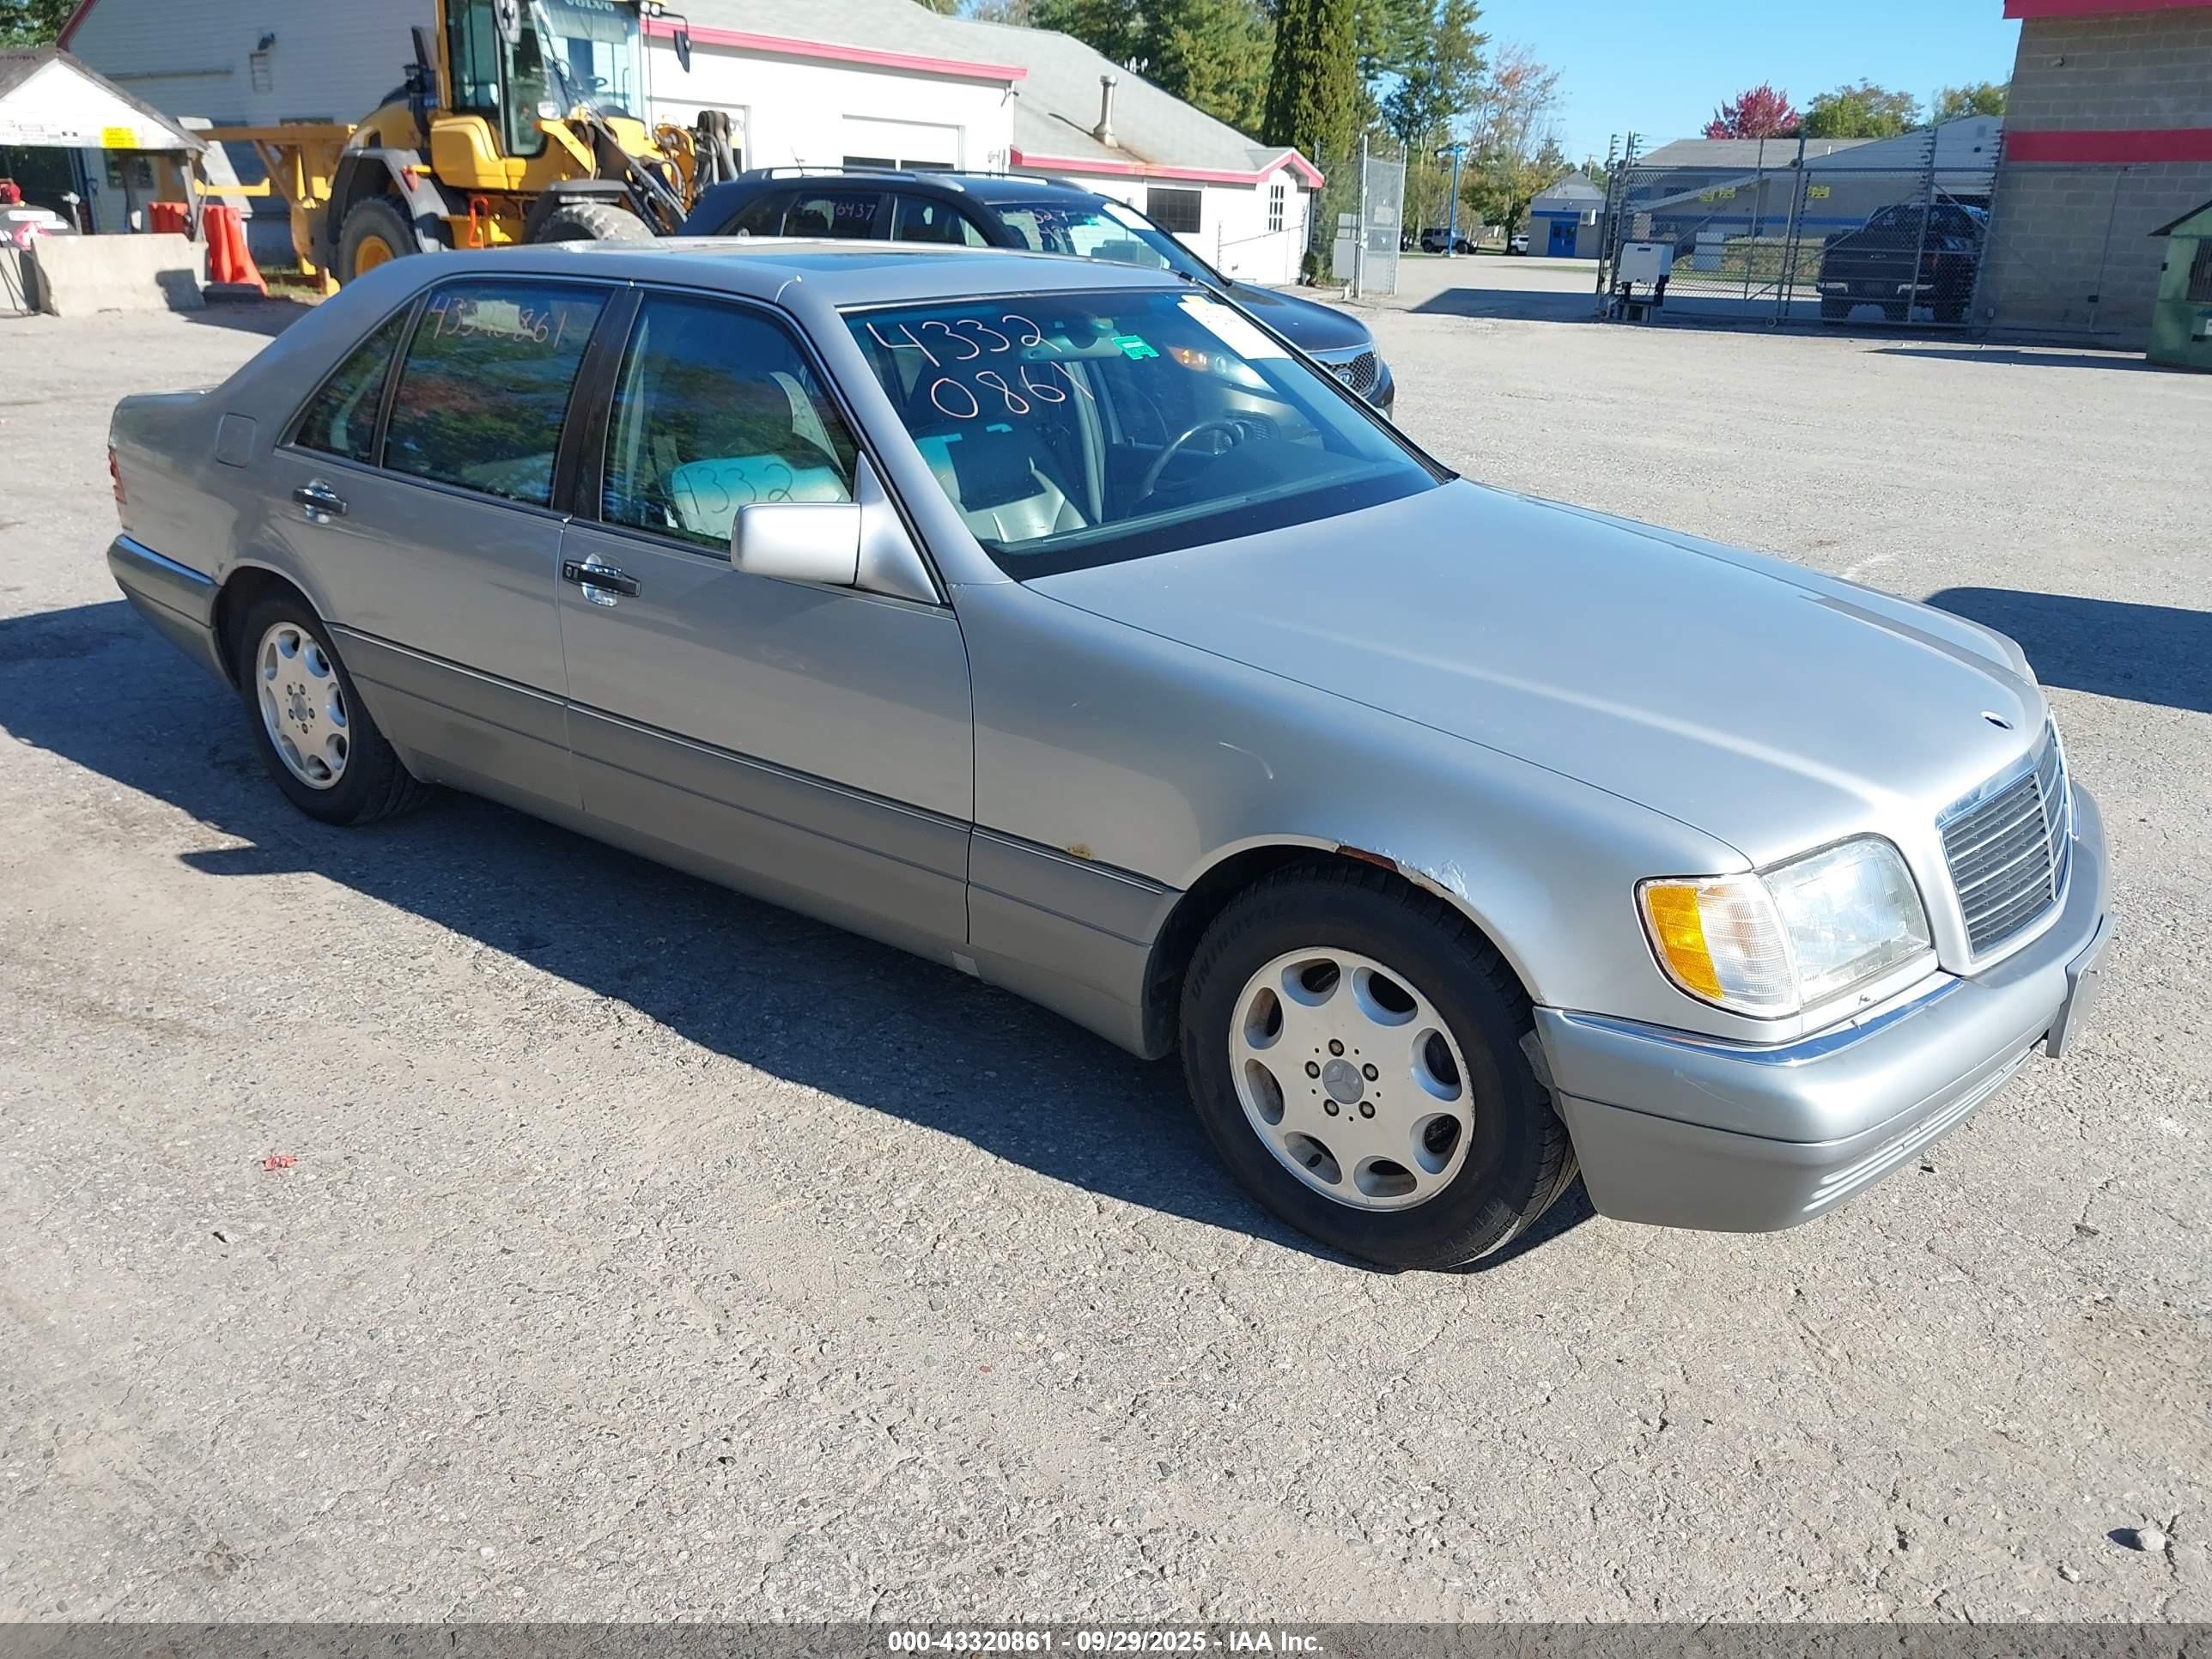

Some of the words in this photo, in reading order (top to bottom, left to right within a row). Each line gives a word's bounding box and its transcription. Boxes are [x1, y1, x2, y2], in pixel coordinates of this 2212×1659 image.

[565, 0, 615, 11] VOLVO
[866, 314, 1062, 368] 4332
[930, 361, 1095, 418] 0861
